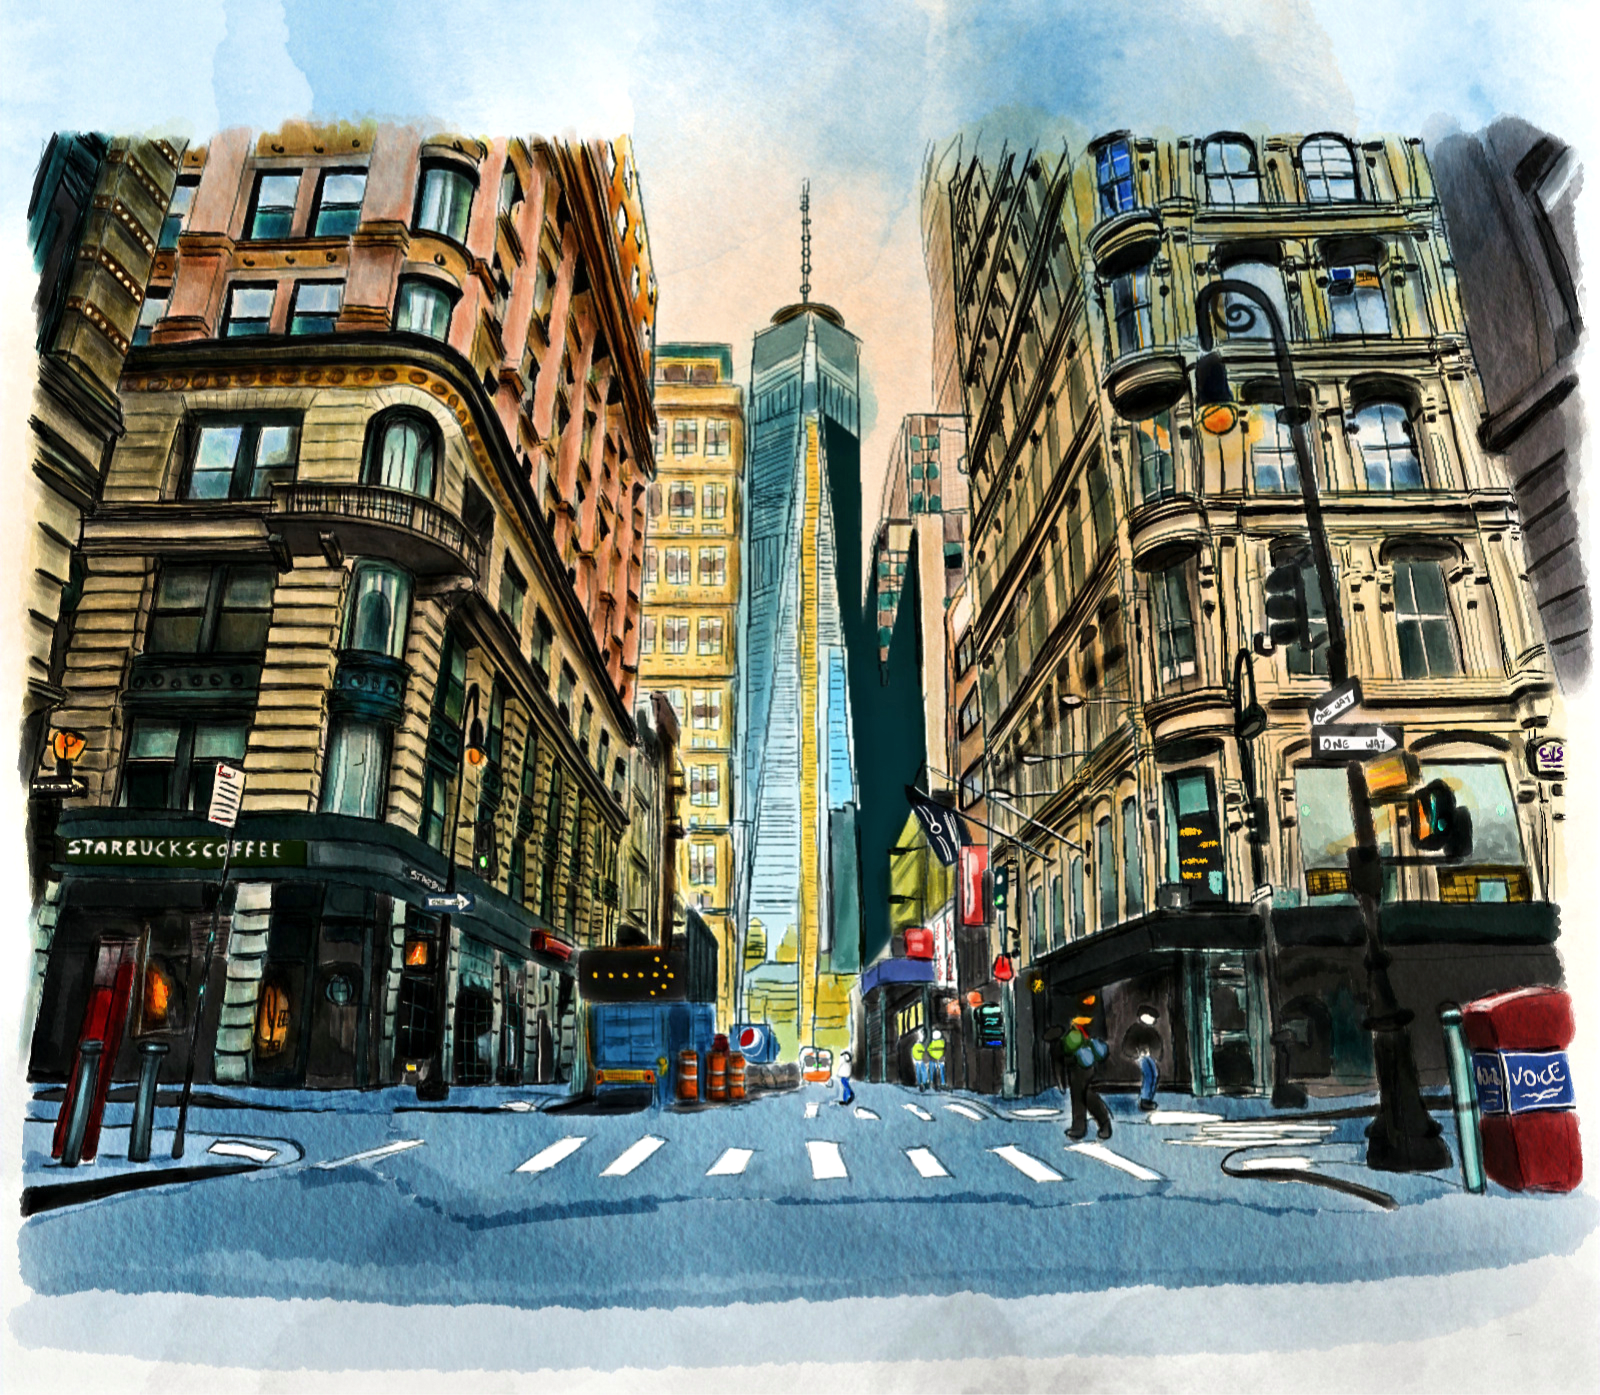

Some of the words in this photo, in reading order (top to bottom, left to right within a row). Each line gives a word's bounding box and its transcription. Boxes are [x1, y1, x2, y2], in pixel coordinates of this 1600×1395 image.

[1315, 707, 1332, 723] ONE
[1323, 738, 1350, 750] ONE
[1365, 738, 1386, 750] WAY
[1539, 746, 1564, 761] CVS
[67, 838, 197, 857] STARBUCKS
[202, 840, 282, 858] COFFEE
[1511, 1061, 1566, 1087] VOICE
